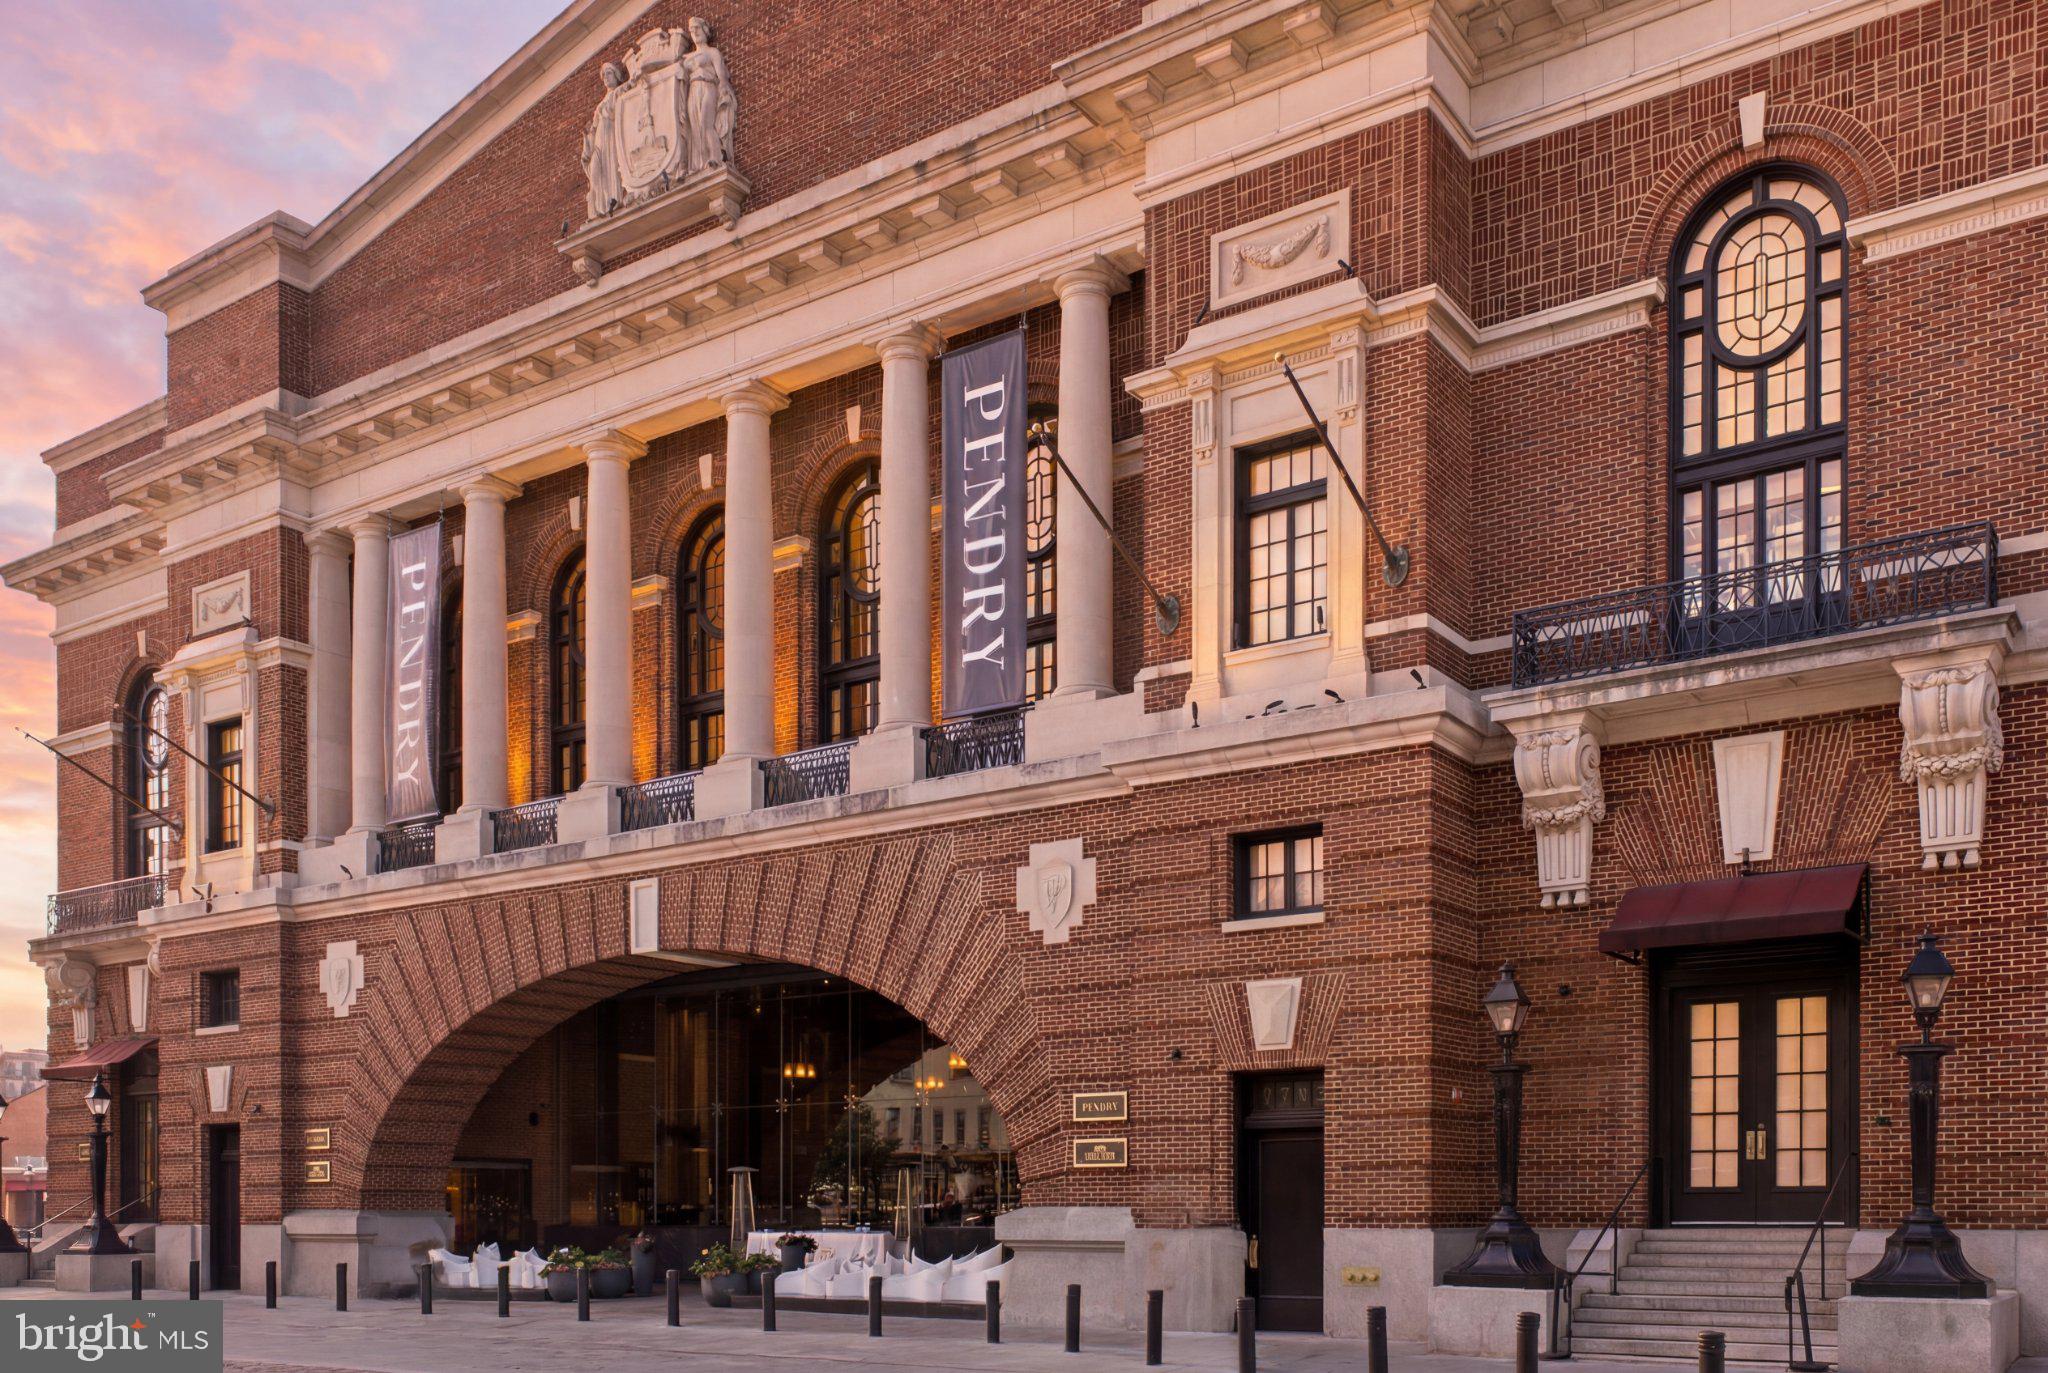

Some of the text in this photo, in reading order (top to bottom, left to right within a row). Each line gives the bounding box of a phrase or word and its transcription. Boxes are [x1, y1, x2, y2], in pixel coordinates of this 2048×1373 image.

[964, 374, 1007, 670] PENDRY
[397, 556, 427, 786] PENDRY
[1082, 1102, 1118, 1112] PENDRY
